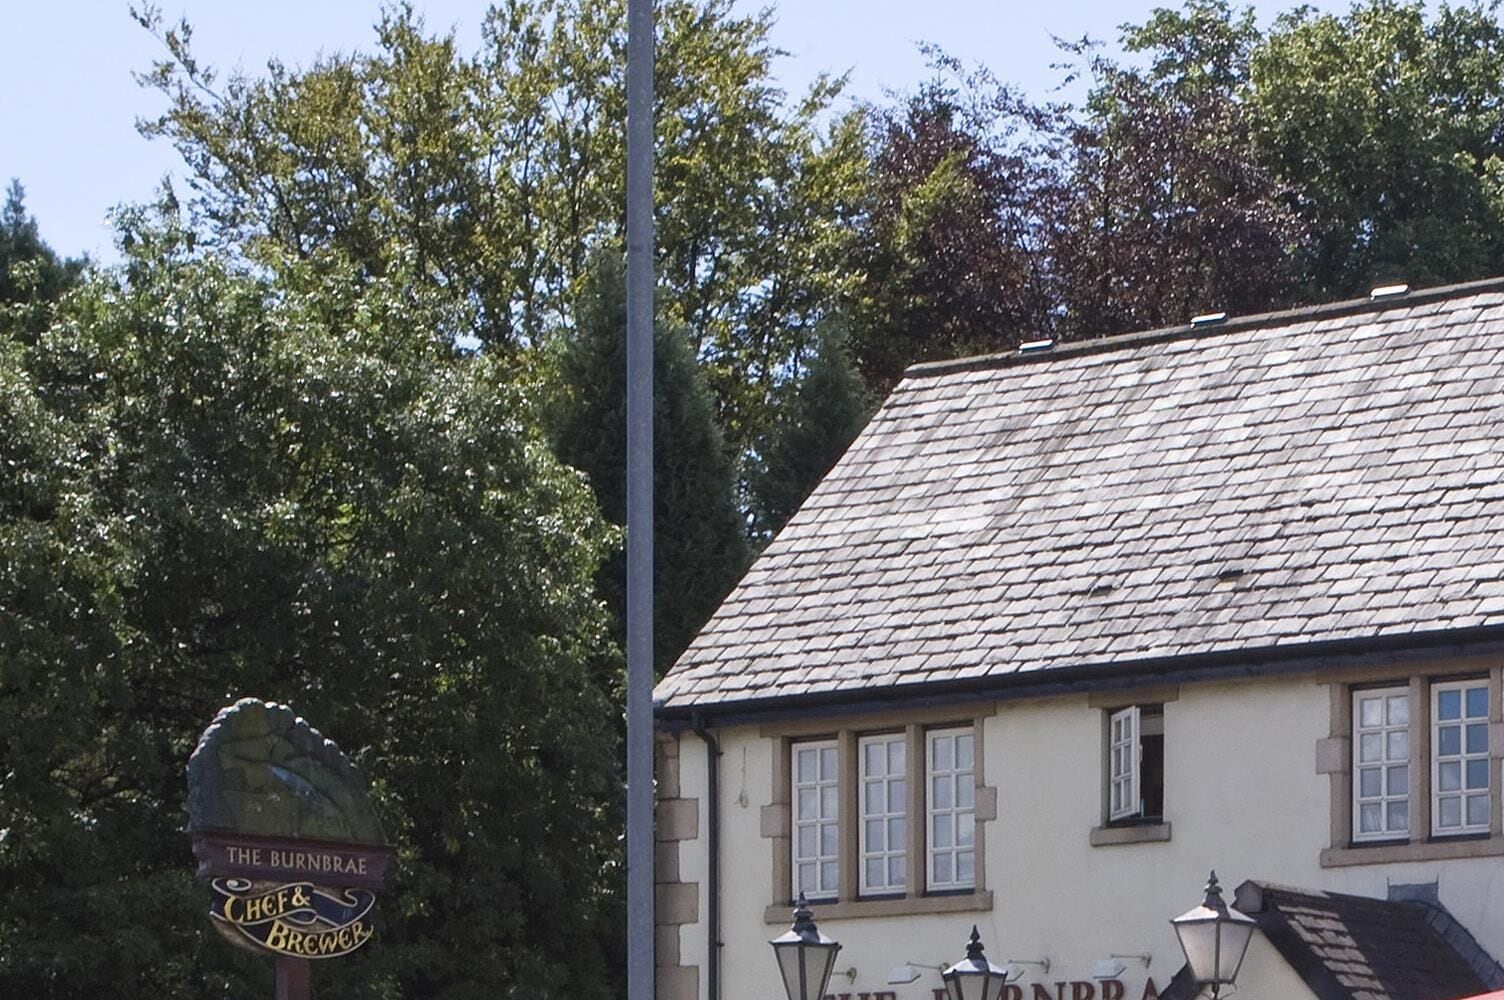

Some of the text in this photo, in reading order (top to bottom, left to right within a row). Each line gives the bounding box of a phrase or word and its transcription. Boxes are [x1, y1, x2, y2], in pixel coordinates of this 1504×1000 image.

[226, 846, 368, 876] THE BURNBRAE
[224, 886, 311, 924] CHEF &
[265, 919, 374, 956] BREWER
